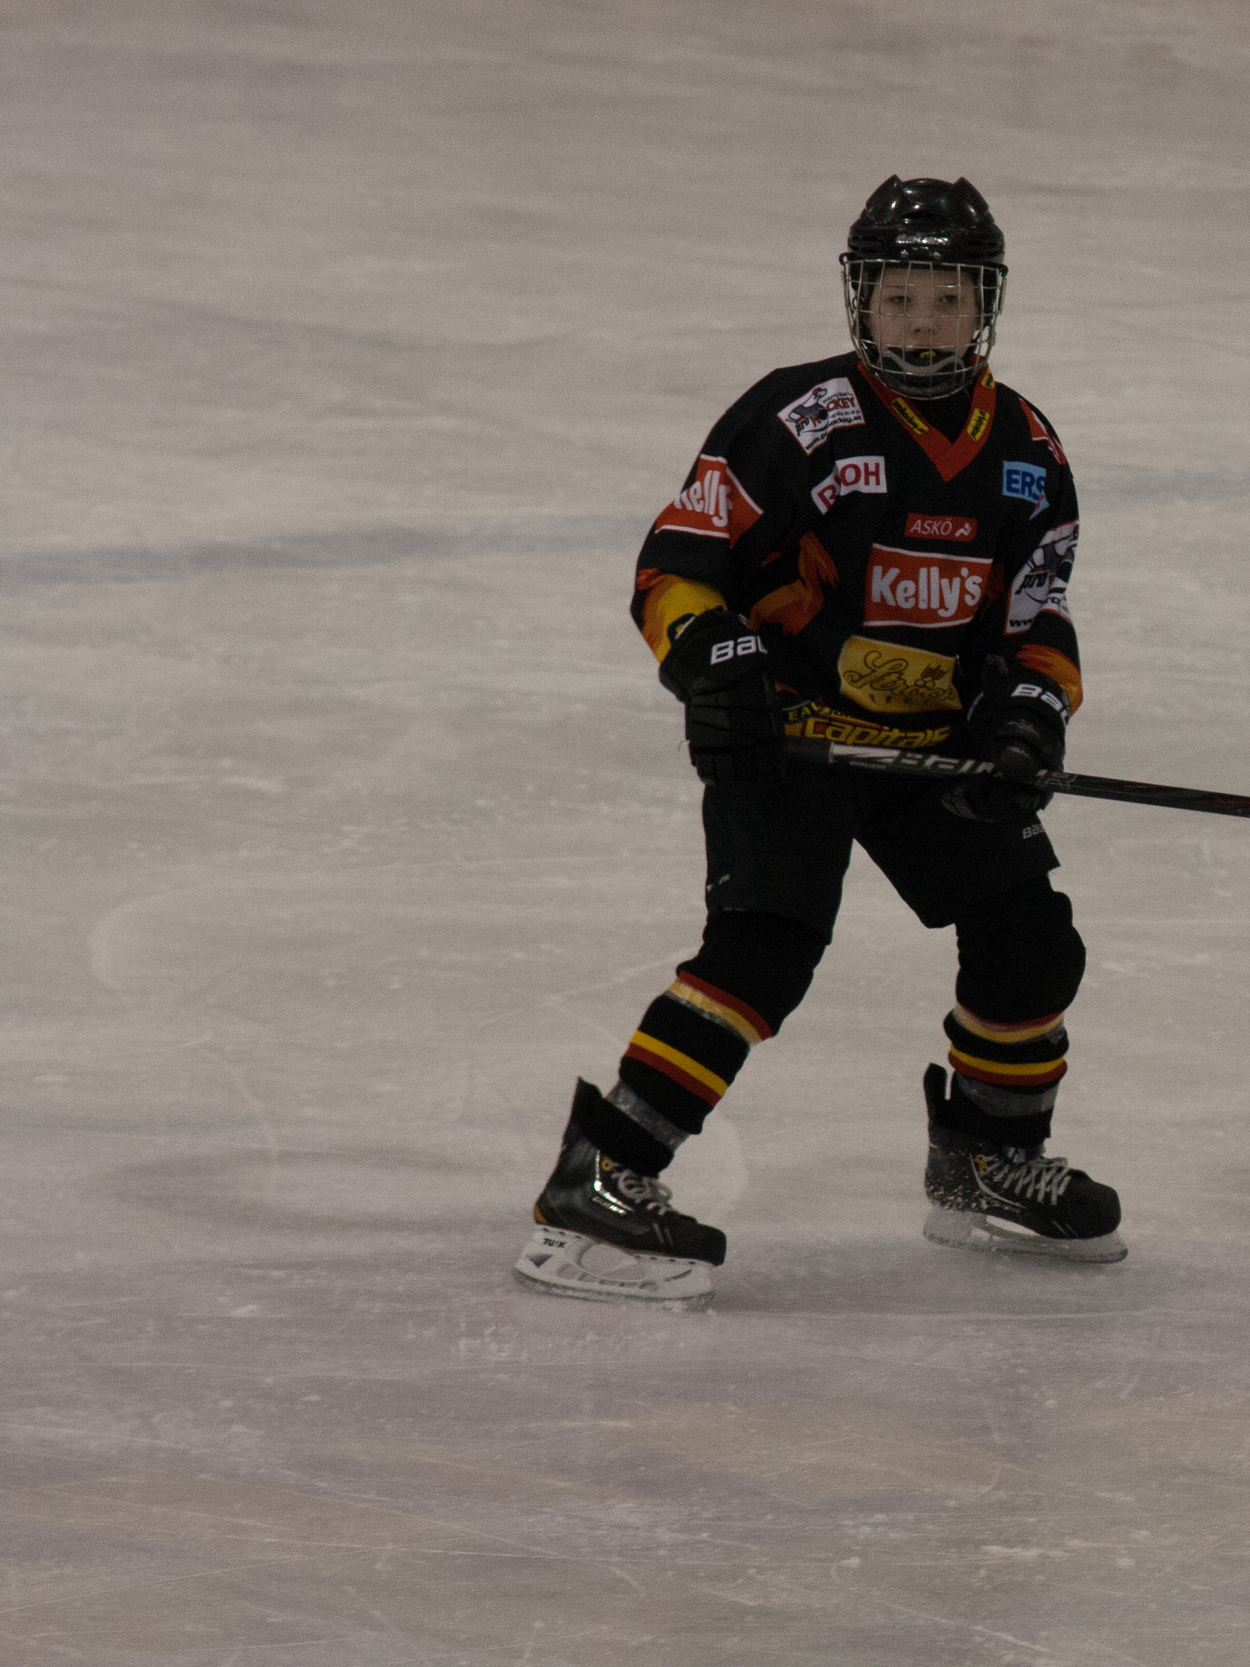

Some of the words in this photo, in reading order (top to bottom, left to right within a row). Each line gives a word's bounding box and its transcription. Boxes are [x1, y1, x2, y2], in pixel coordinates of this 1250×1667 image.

[810, 397, 856, 428] HCKEY
[909, 518, 953, 536] ASKÖ
[870, 564, 983, 618] Kelly's
